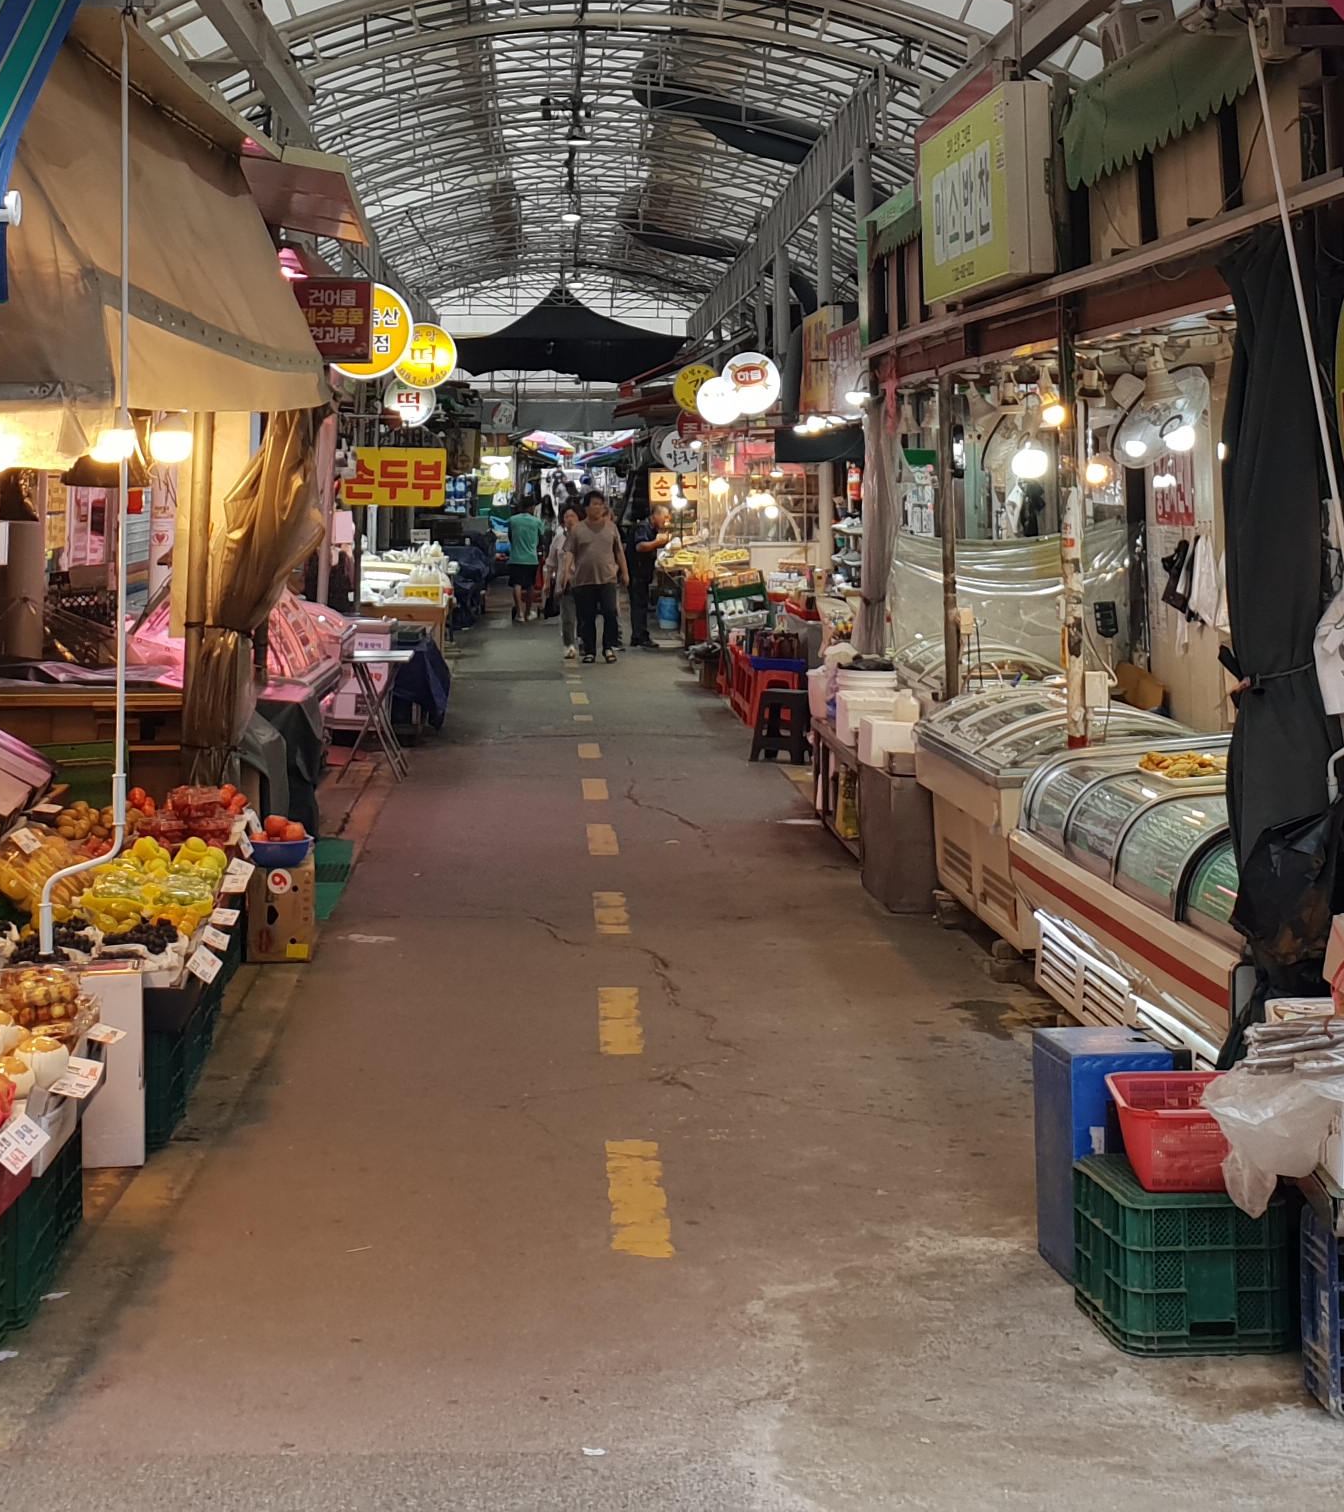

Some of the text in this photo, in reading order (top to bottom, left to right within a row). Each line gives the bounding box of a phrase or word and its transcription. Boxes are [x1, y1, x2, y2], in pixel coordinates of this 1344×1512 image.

[308, 289, 357, 307] 건어물
[410, 344, 437, 373] 떡
[396, 391, 421, 412] 떡
[344, 459, 444, 501] 손두부
